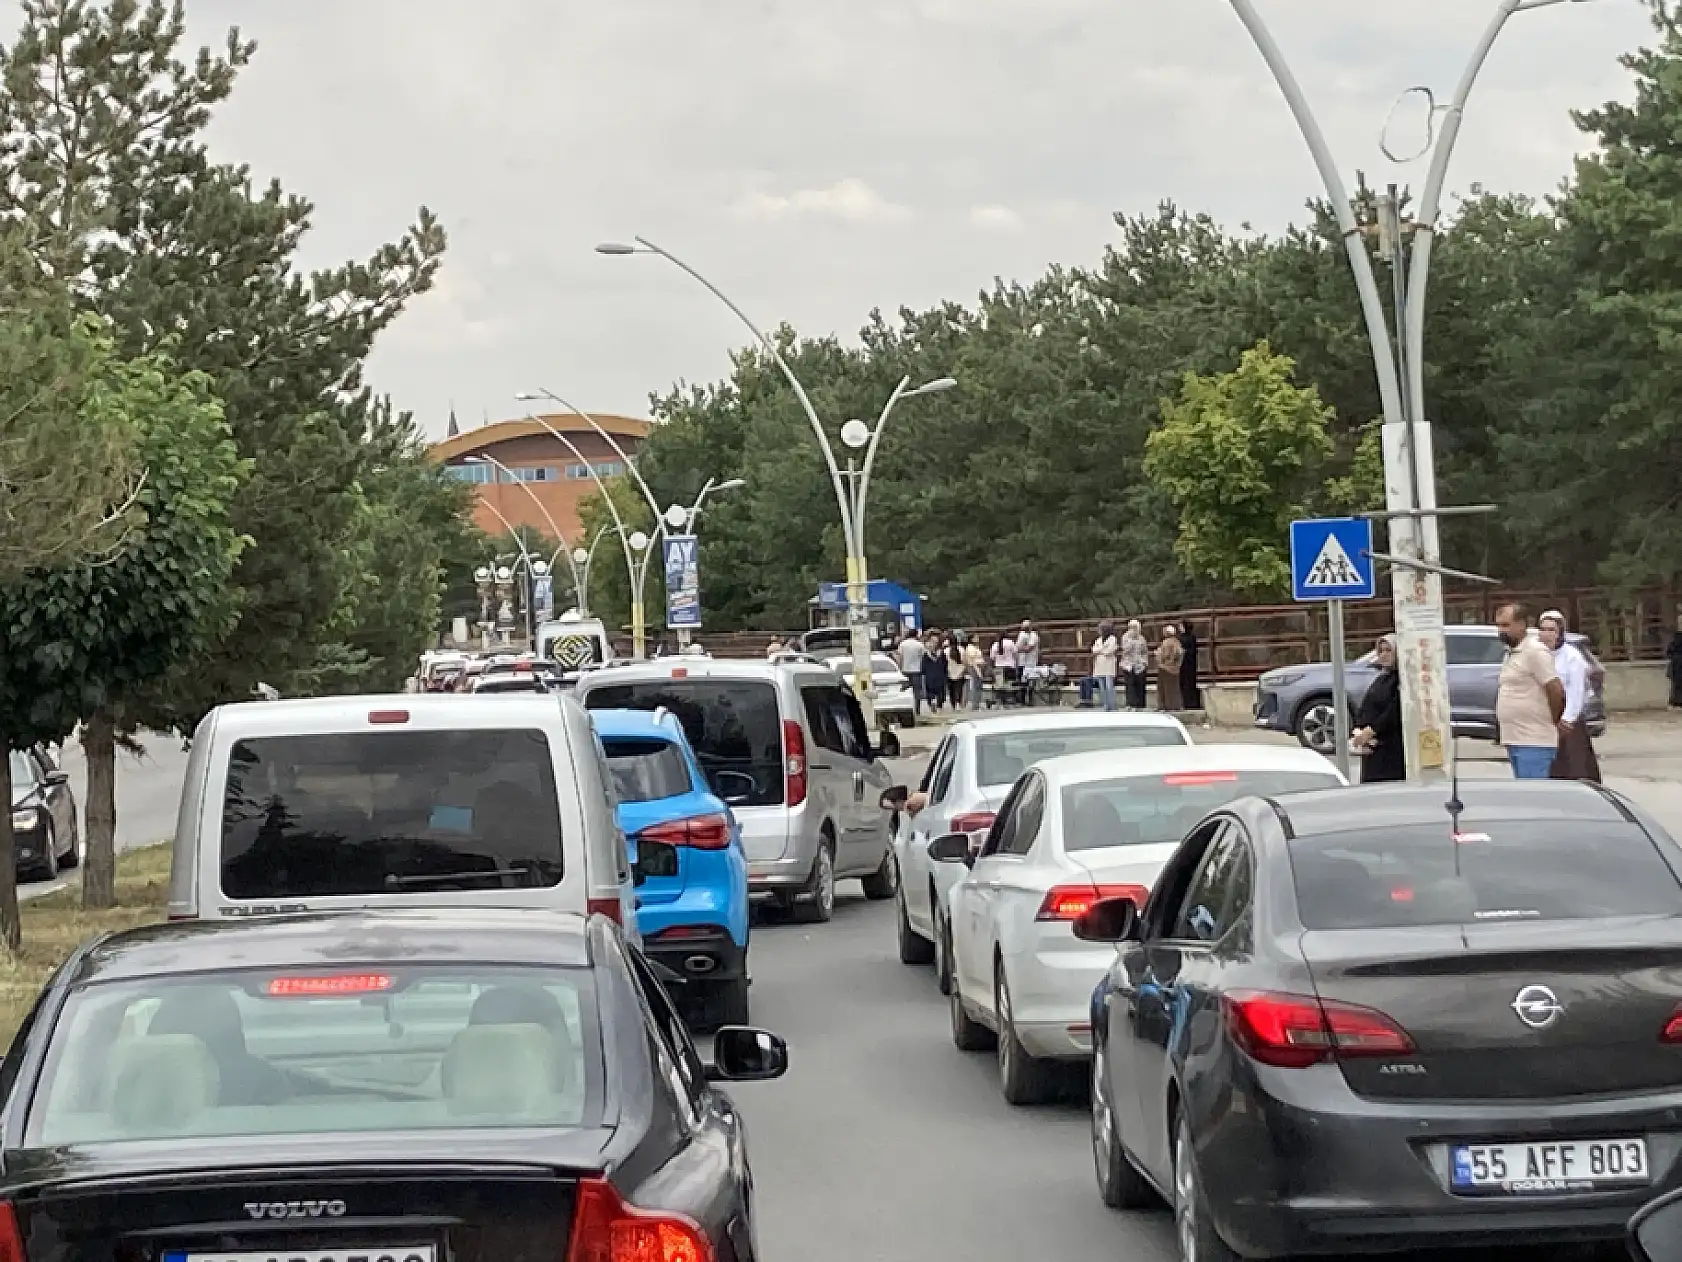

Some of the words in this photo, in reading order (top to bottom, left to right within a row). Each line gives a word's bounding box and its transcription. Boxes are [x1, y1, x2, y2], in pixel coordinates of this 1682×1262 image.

[1471, 1149, 1507, 1179] 55
[1526, 1145, 1575, 1177] AFF
[1589, 1143, 1643, 1174] 803
[243, 1200, 347, 1218] VOLVO
